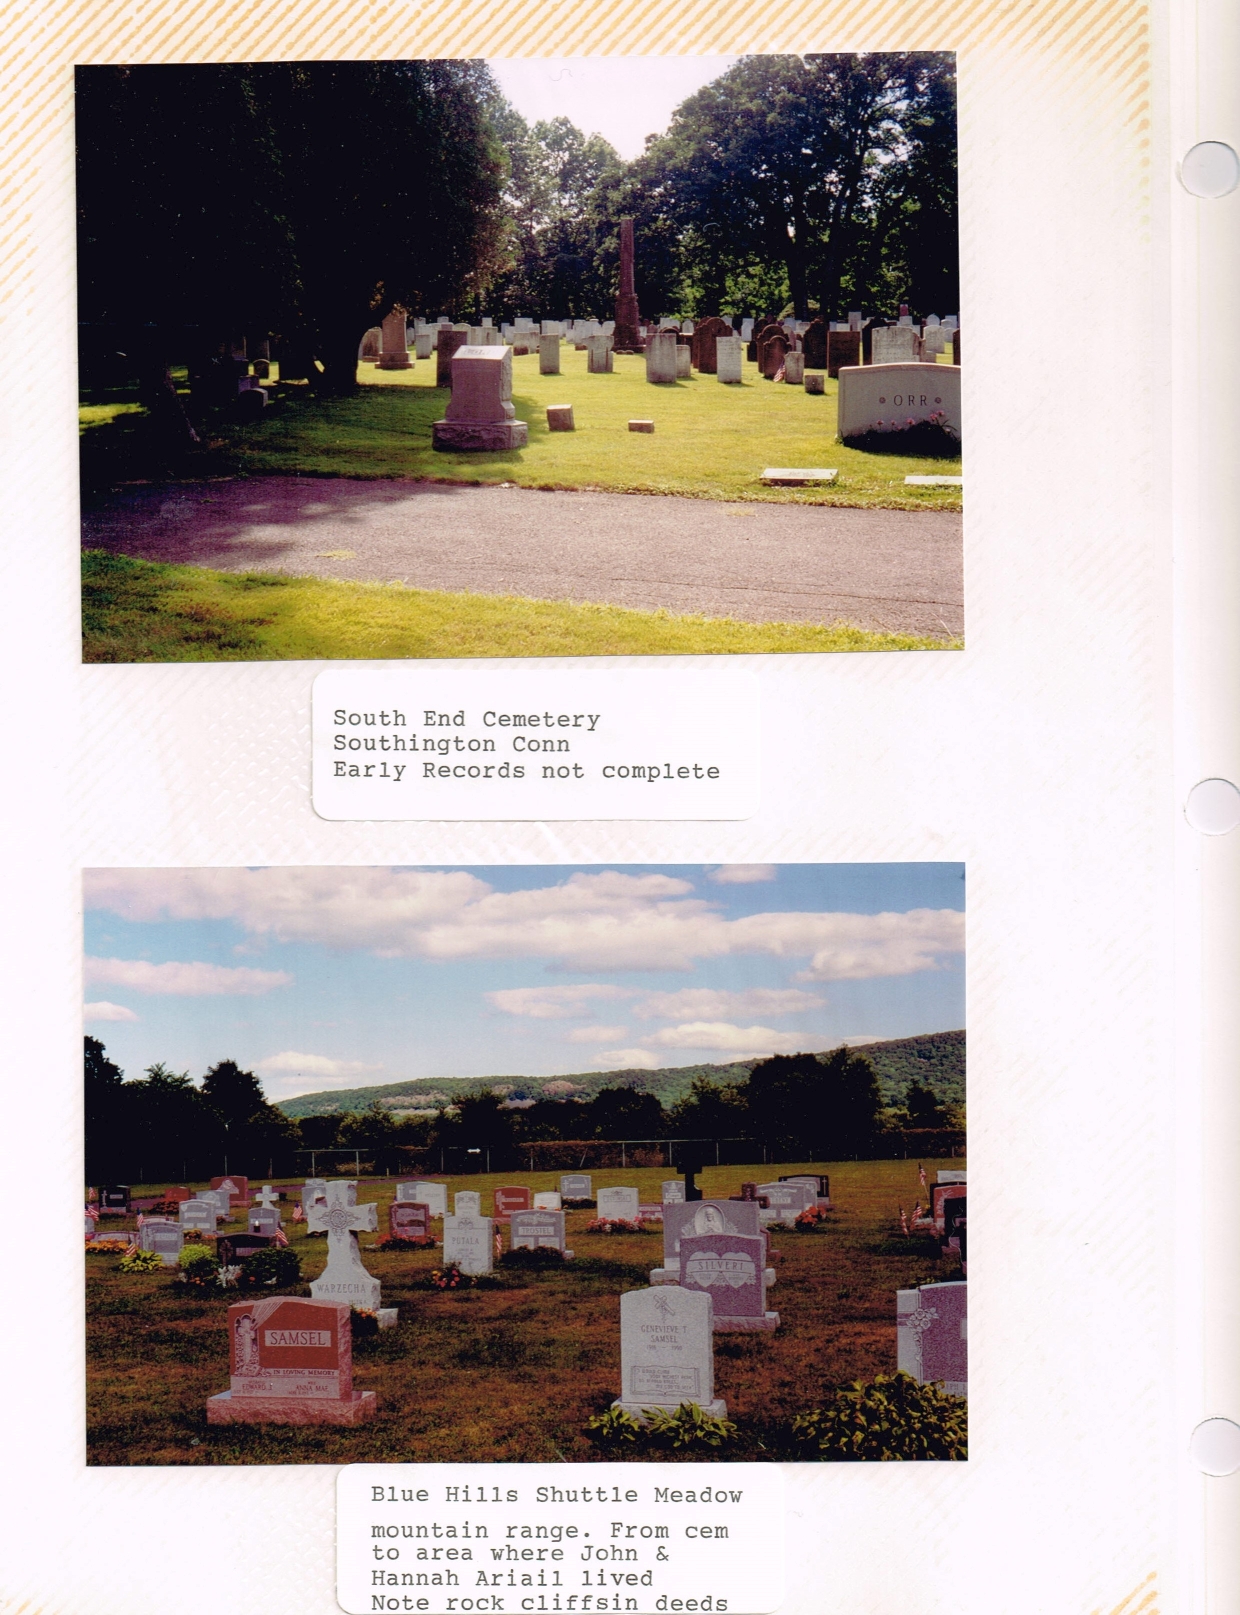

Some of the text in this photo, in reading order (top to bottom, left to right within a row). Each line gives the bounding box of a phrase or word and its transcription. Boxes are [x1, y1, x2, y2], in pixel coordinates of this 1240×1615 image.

[893, 394, 928, 407] ORR
[333, 709, 601, 732] South End Cemetery
[333, 733, 570, 756] Southington Conn
[333, 761, 720, 783] Early Records not complete
[316, 1283, 366, 1294] WARZECHA
[270, 1331, 326, 1346] SAMSEL
[640, 1325, 679, 1334] GENEVIEVE
[650, 1334, 678, 1343] SAMSEL
[296, 1384, 313, 1392] ANNA
[371, 1484, 743, 1503] Blue Hills Shuttle Meadow
[371, 1520, 729, 1543] mountain range. From cem
[372, 1544, 669, 1561] to area where John &
[371, 1568, 653, 1587] Hannah Ariail lived
[371, 1593, 728, 1612] Note rock cliffsin deeds
